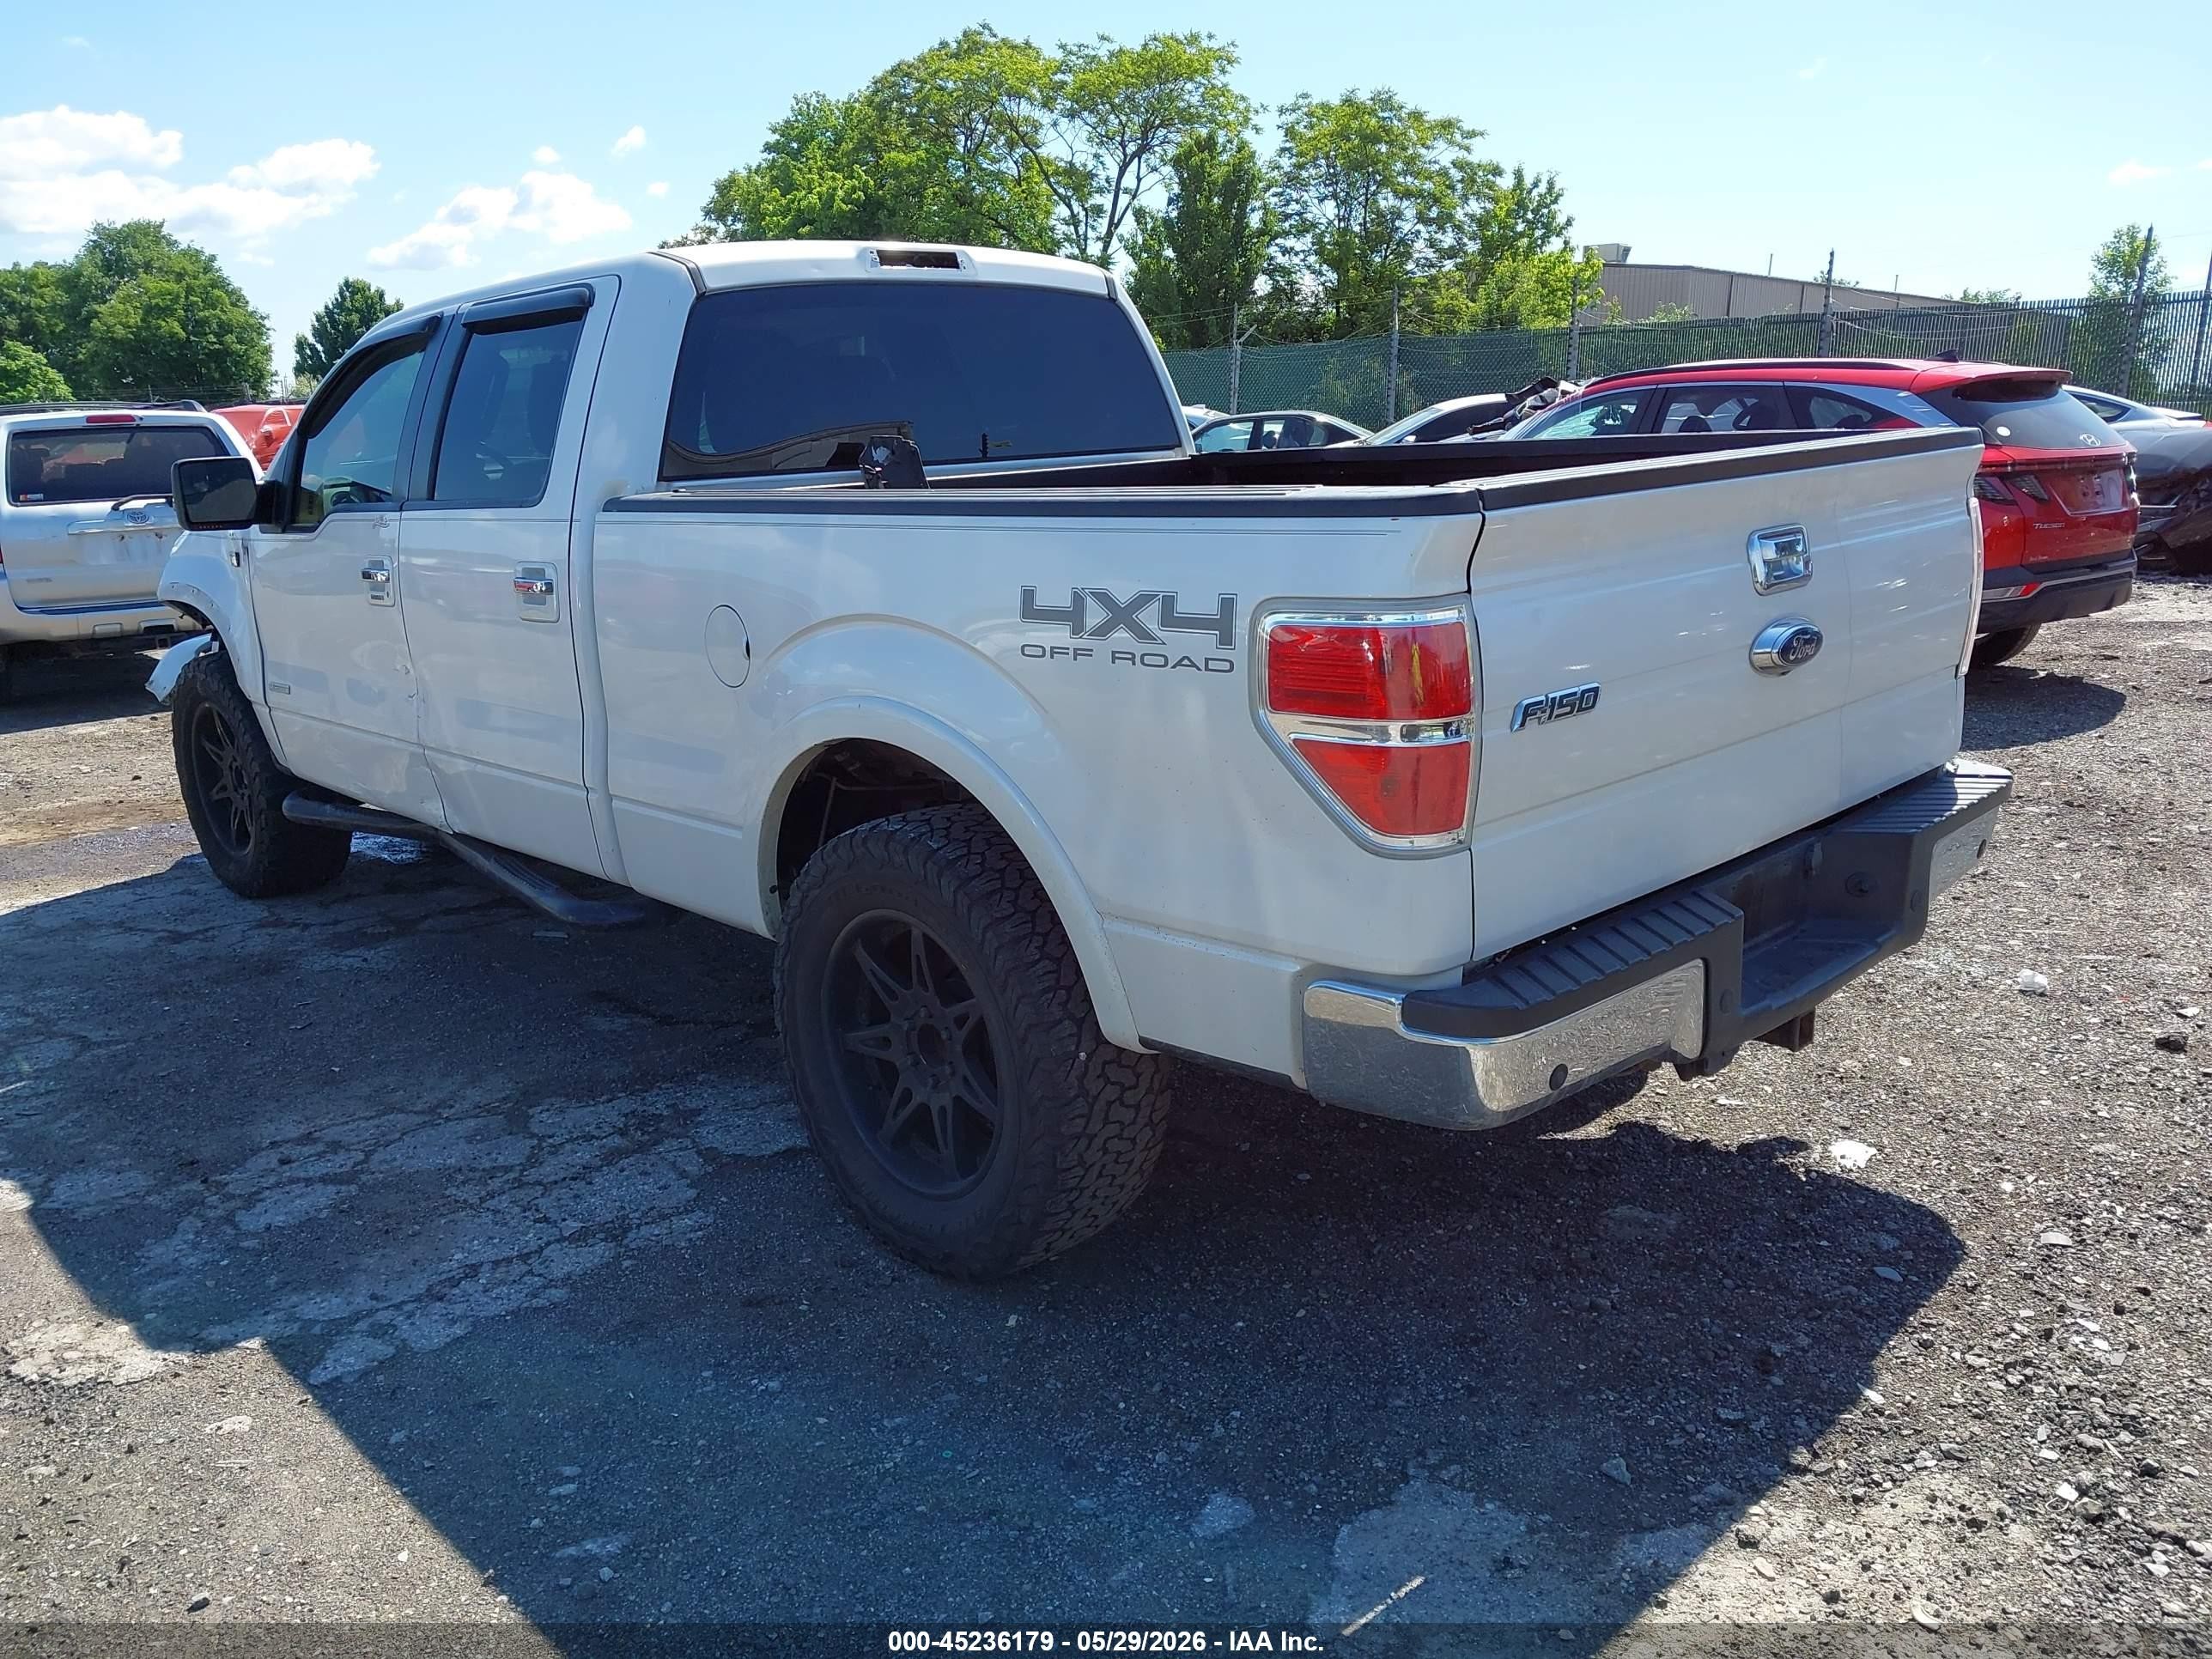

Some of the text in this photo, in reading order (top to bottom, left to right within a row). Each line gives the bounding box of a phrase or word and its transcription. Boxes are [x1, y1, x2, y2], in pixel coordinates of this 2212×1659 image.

[1019, 586, 1237, 650] 4X4
[1020, 643, 1235, 673] OFF ROAD
[1790, 635, 1818, 660] Ford
